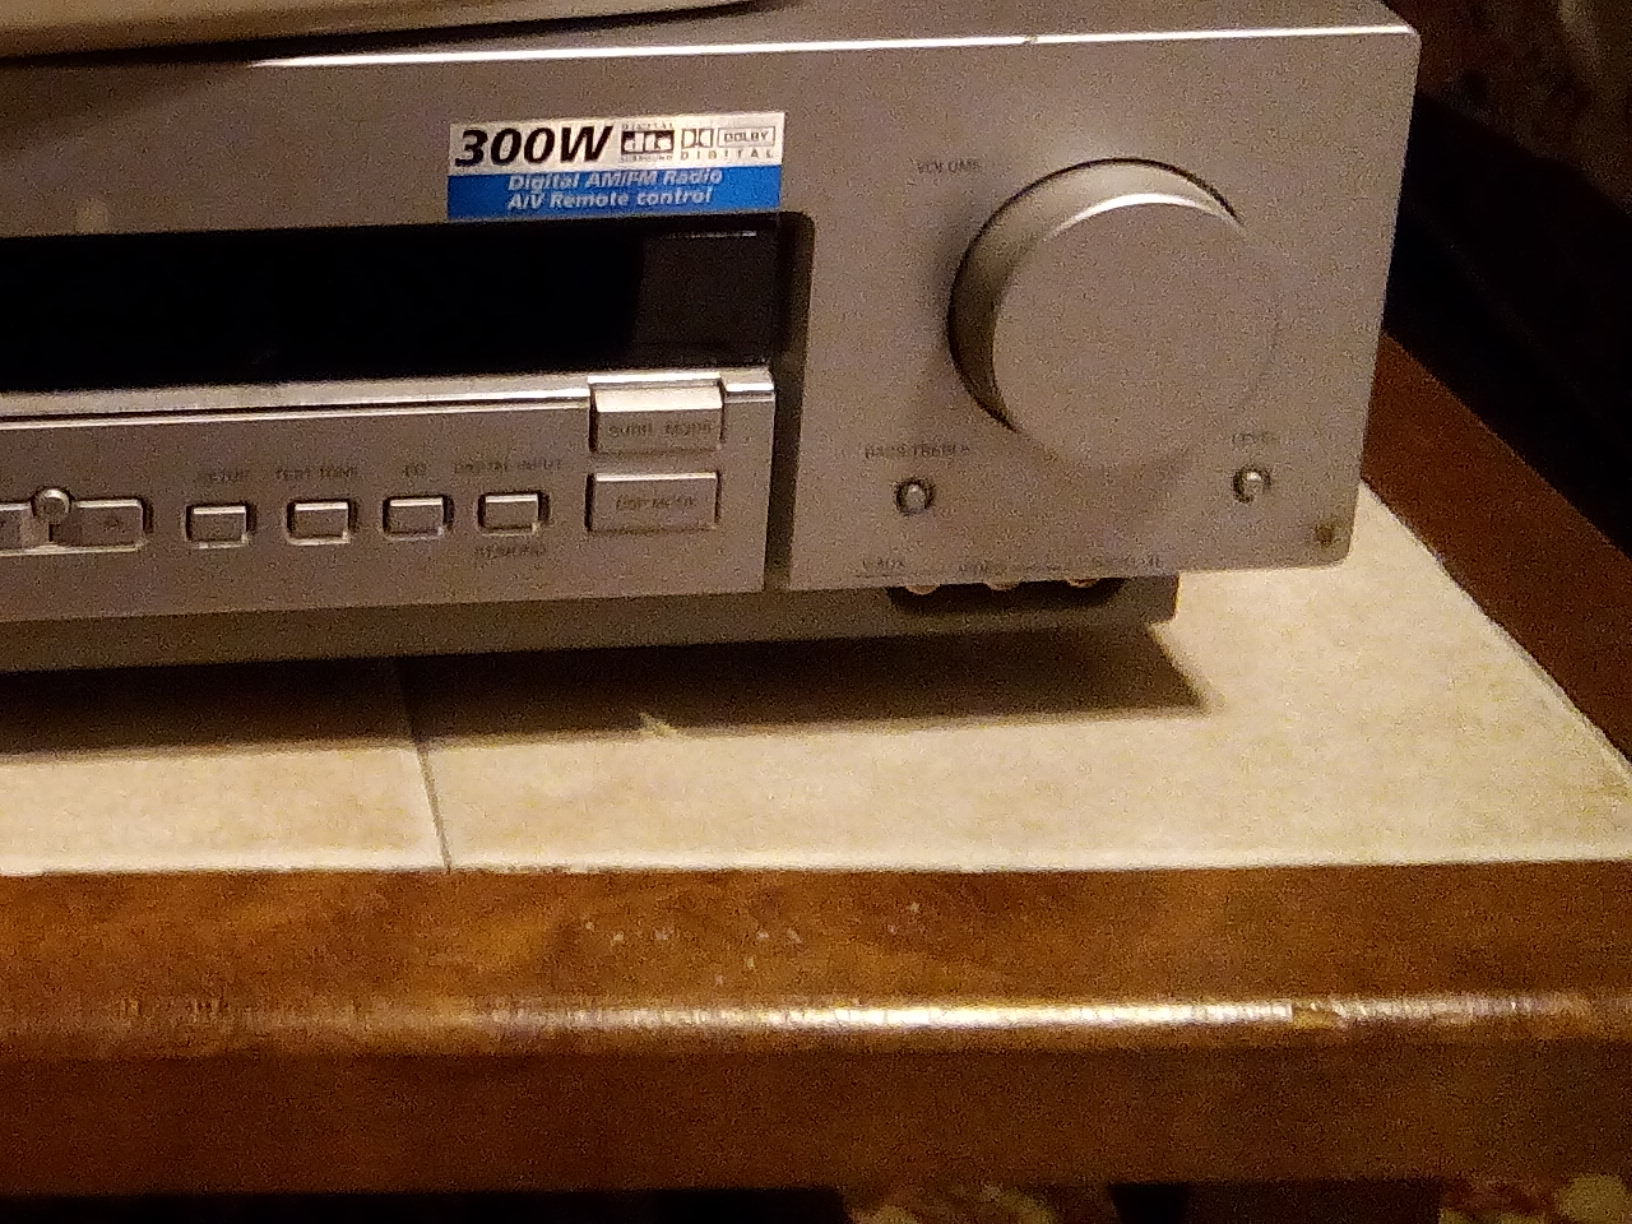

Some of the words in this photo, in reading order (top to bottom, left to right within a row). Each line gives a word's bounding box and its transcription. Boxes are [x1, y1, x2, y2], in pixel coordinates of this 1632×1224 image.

[454, 125, 615, 167] 300W
[724, 131, 768, 143] DOLBY
[681, 148, 773, 161] DIGITAL
[508, 174, 580, 192] Digital
[663, 167, 723, 185] Radio
[549, 191, 629, 209] Remote
[636, 186, 713, 206] control
